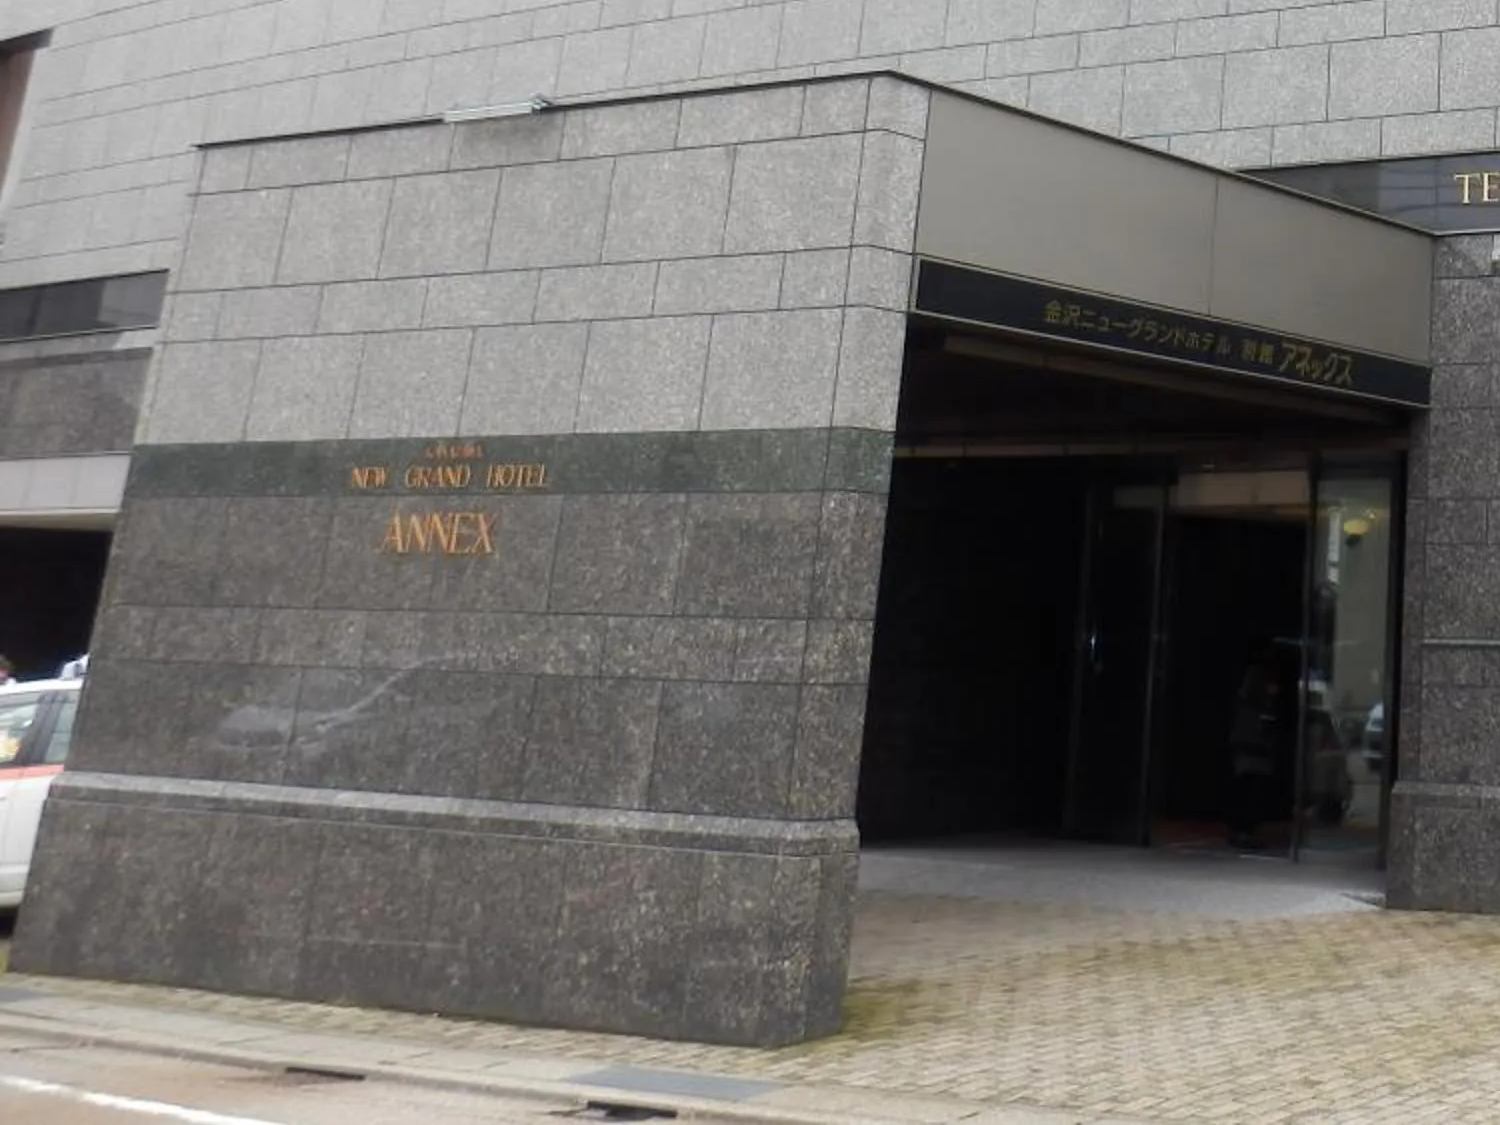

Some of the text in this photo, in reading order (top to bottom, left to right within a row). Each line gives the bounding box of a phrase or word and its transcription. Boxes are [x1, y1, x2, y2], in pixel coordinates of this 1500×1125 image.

[404, 464, 471, 488] GRAND
[486, 463, 548, 488] HOTEL
[382, 511, 497, 554] ANNEX
